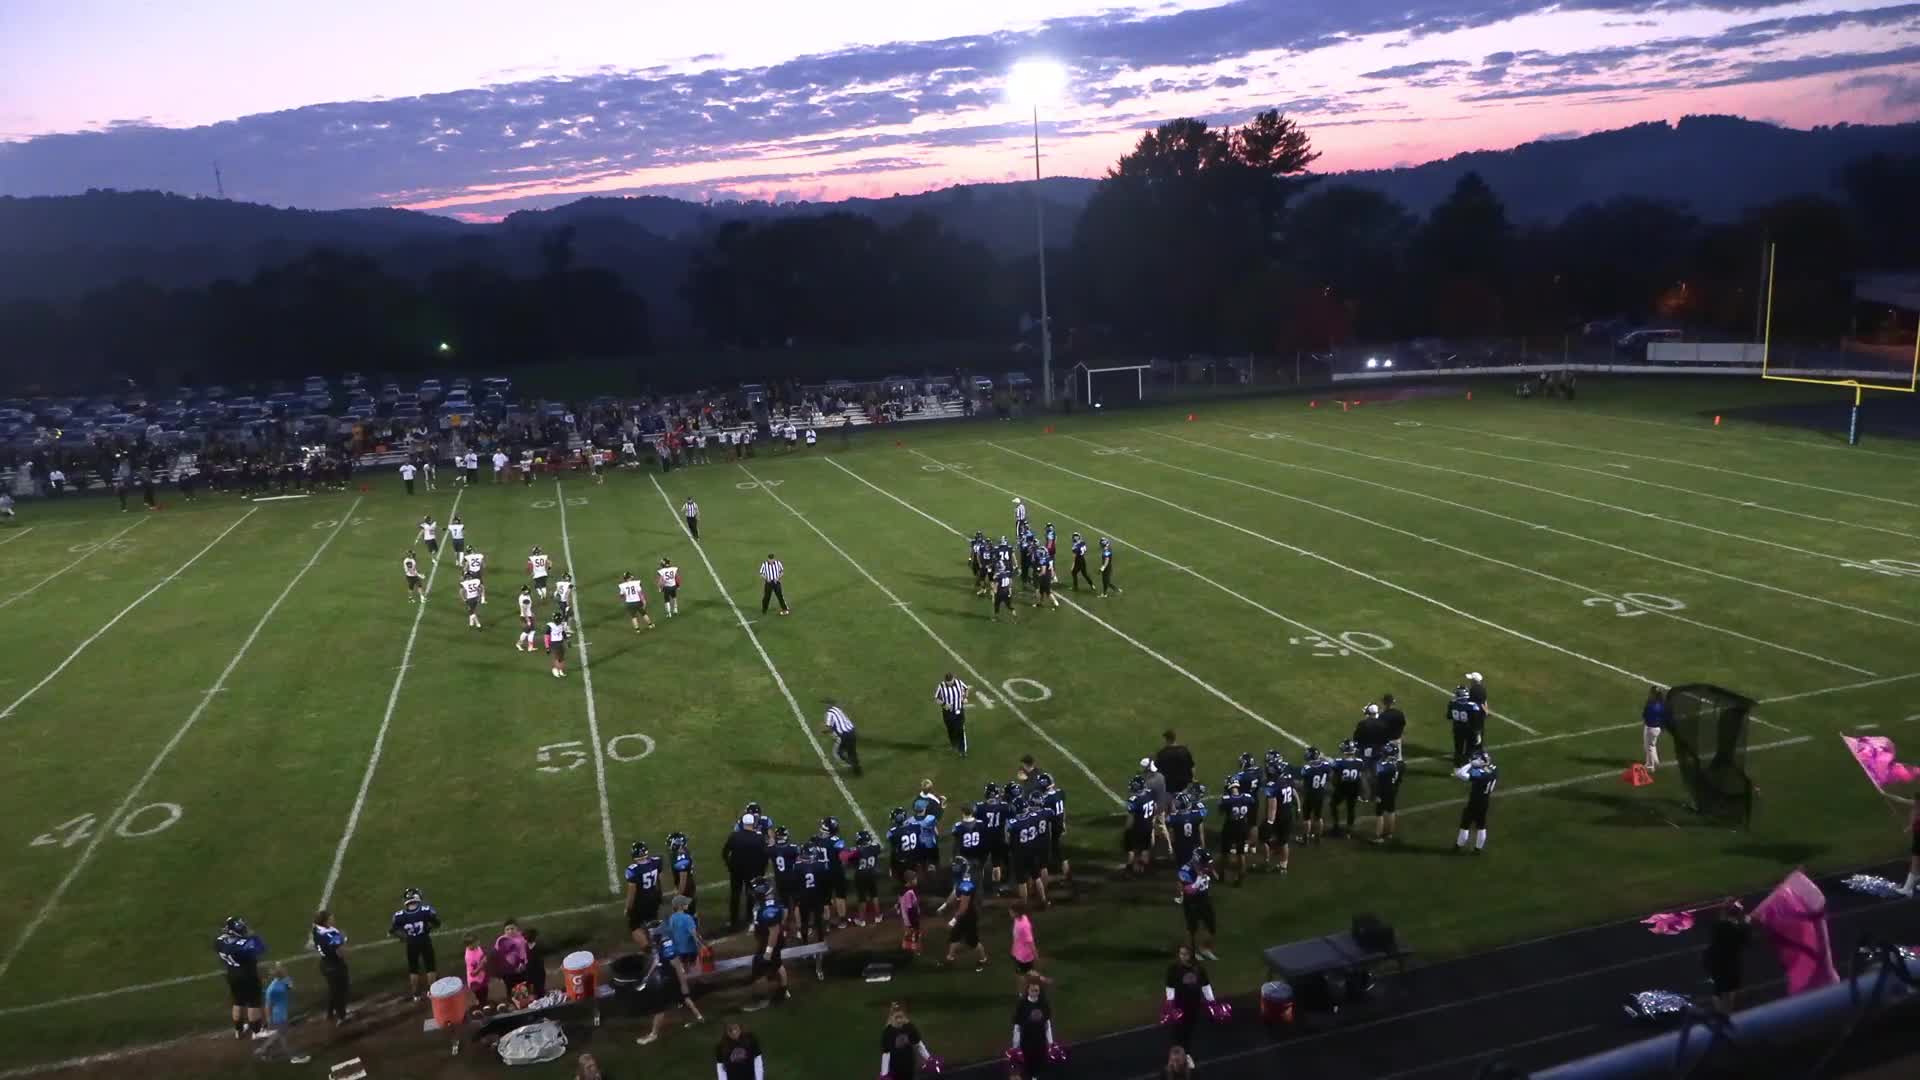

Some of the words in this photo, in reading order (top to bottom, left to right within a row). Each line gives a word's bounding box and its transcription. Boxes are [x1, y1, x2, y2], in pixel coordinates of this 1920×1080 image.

[471, 558, 480, 568] 25
[534, 558, 545, 568] 50
[468, 582, 477, 593] 55
[625, 585, 637, 596] 78
[1582, 592, 1686, 617] 20
[1288, 631, 1393, 656] 30
[536, 733, 656, 773] 50
[1312, 773, 1328, 790] 84
[1281, 785, 1293, 805] 72
[1142, 800, 1154, 819] 75
[29, 802, 184, 849] 40
[901, 832, 917, 852] 29
[963, 831, 980, 848] 20
[776, 856, 785, 872] 9
[642, 868, 659, 889] 57
[805, 872, 815, 889] 2
[403, 921, 424, 936] 27
